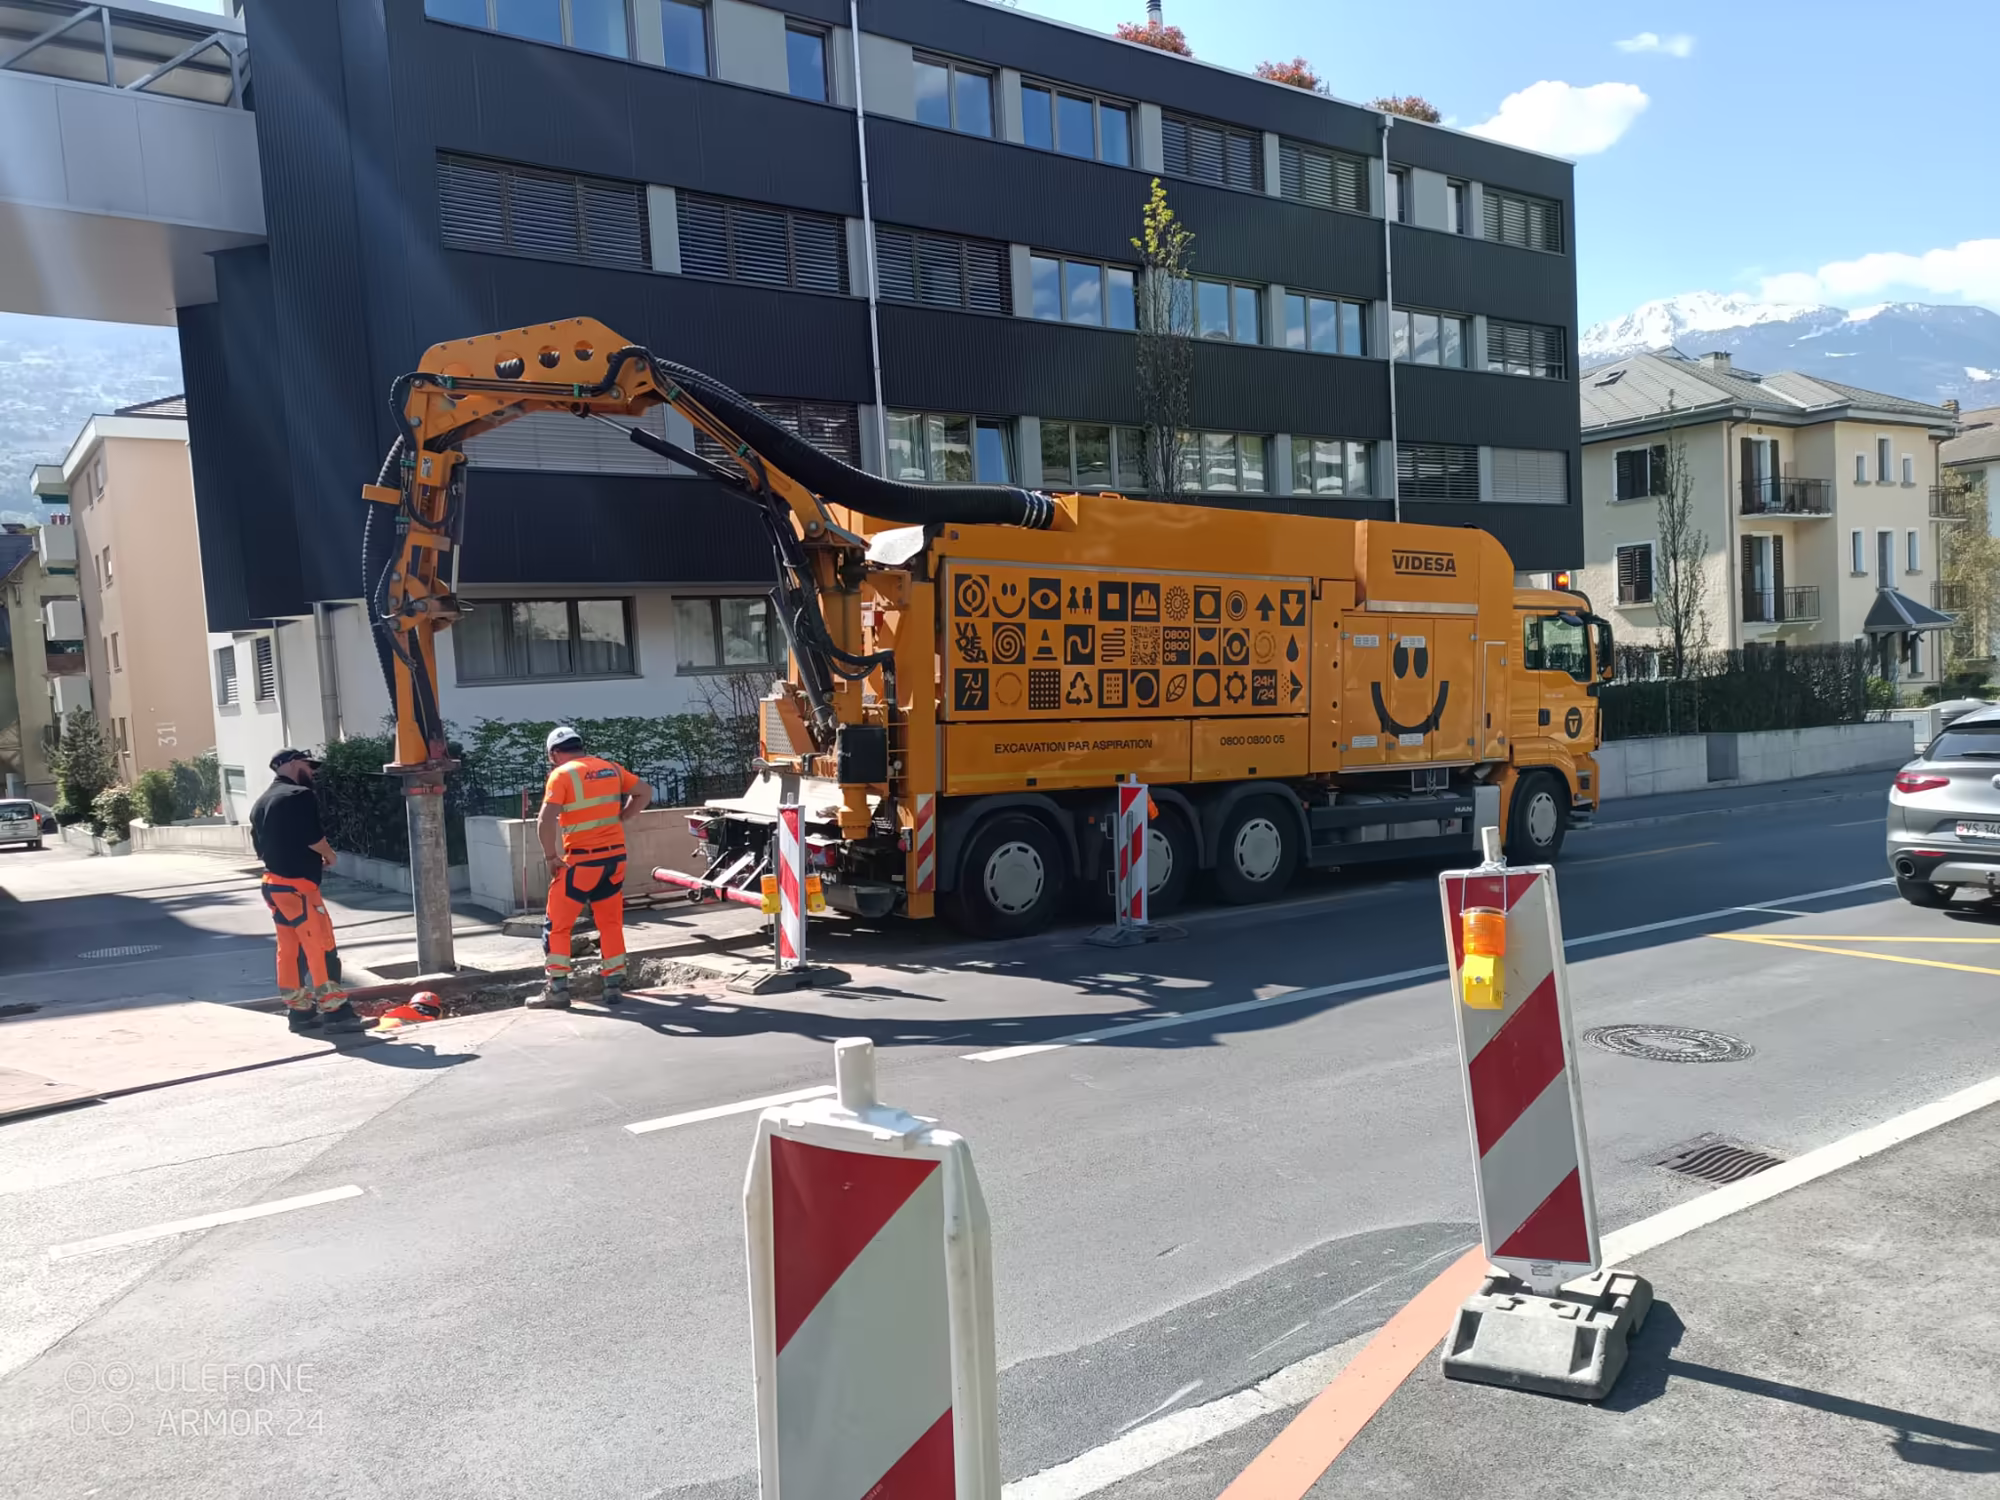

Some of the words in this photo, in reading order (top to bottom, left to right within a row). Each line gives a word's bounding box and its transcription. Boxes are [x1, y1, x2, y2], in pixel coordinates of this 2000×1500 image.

[1392, 554, 1457, 573] VIDESA
[1165, 630, 1190, 640] 0800
[1164, 641, 1190, 651] 0800
[1164, 652, 1177, 662] 05
[1254, 675, 1276, 687] 24H
[1257, 689, 1276, 700] /24
[1220, 736, 1246, 746] 0800
[1247, 735, 1272, 745] 0800
[1273, 734, 1286, 744] 05
[994, 742, 1066, 754] EXCAVATION
[1068, 740, 1091, 750] PAR
[1093, 738, 1153, 750] ASPIRATION
